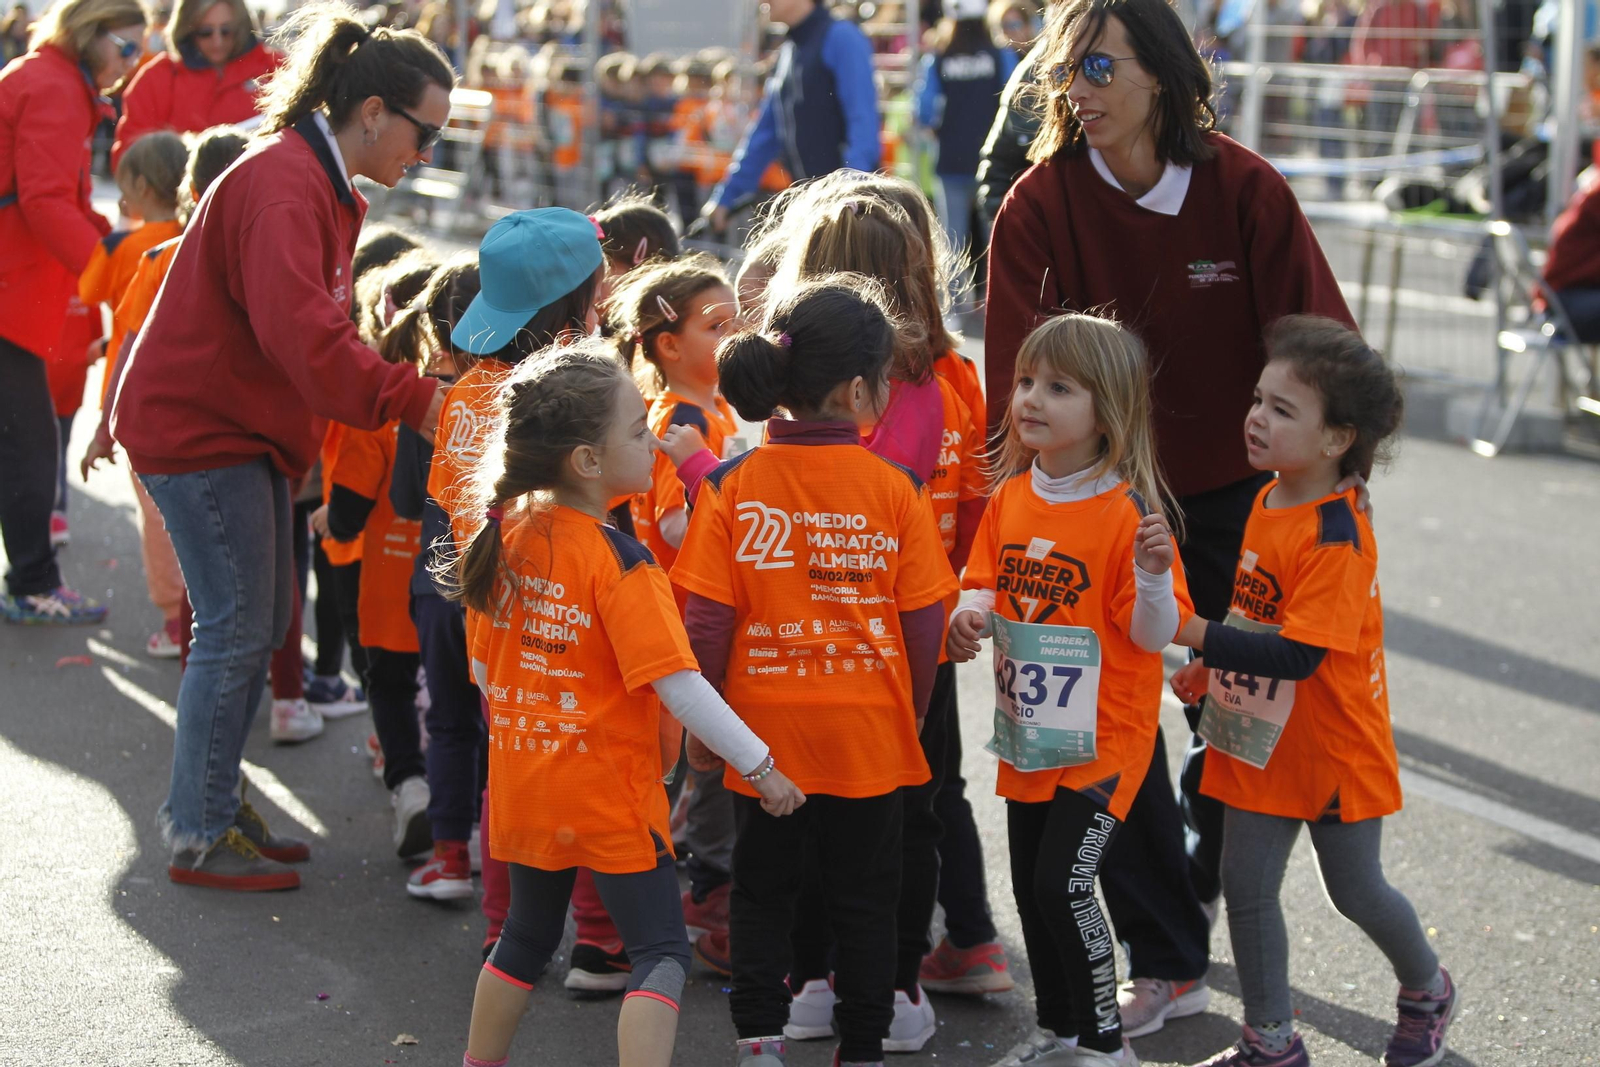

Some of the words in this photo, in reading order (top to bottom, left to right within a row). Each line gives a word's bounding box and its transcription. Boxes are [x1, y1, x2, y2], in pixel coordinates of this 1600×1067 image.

[804, 512, 867, 530] MEDIO
[806, 531, 899, 553] MARATÓN
[808, 550, 888, 571] ALMERÍA
[808, 569, 873, 582] 03/02/2019
[1003, 556, 1074, 587] SUPER
[840, 596, 858, 604] RUIZ
[996, 575, 1080, 610] RUNNER
[1233, 588, 1278, 620] NNER
[1039, 634, 1090, 646] CARRERA
[749, 648, 779, 658] Blanes
[1040, 647, 1090, 658] INFANTIL
[757, 665, 789, 675] cajamar
[1224, 691, 1242, 706] EVA
[1068, 812, 1117, 893] PROVE
